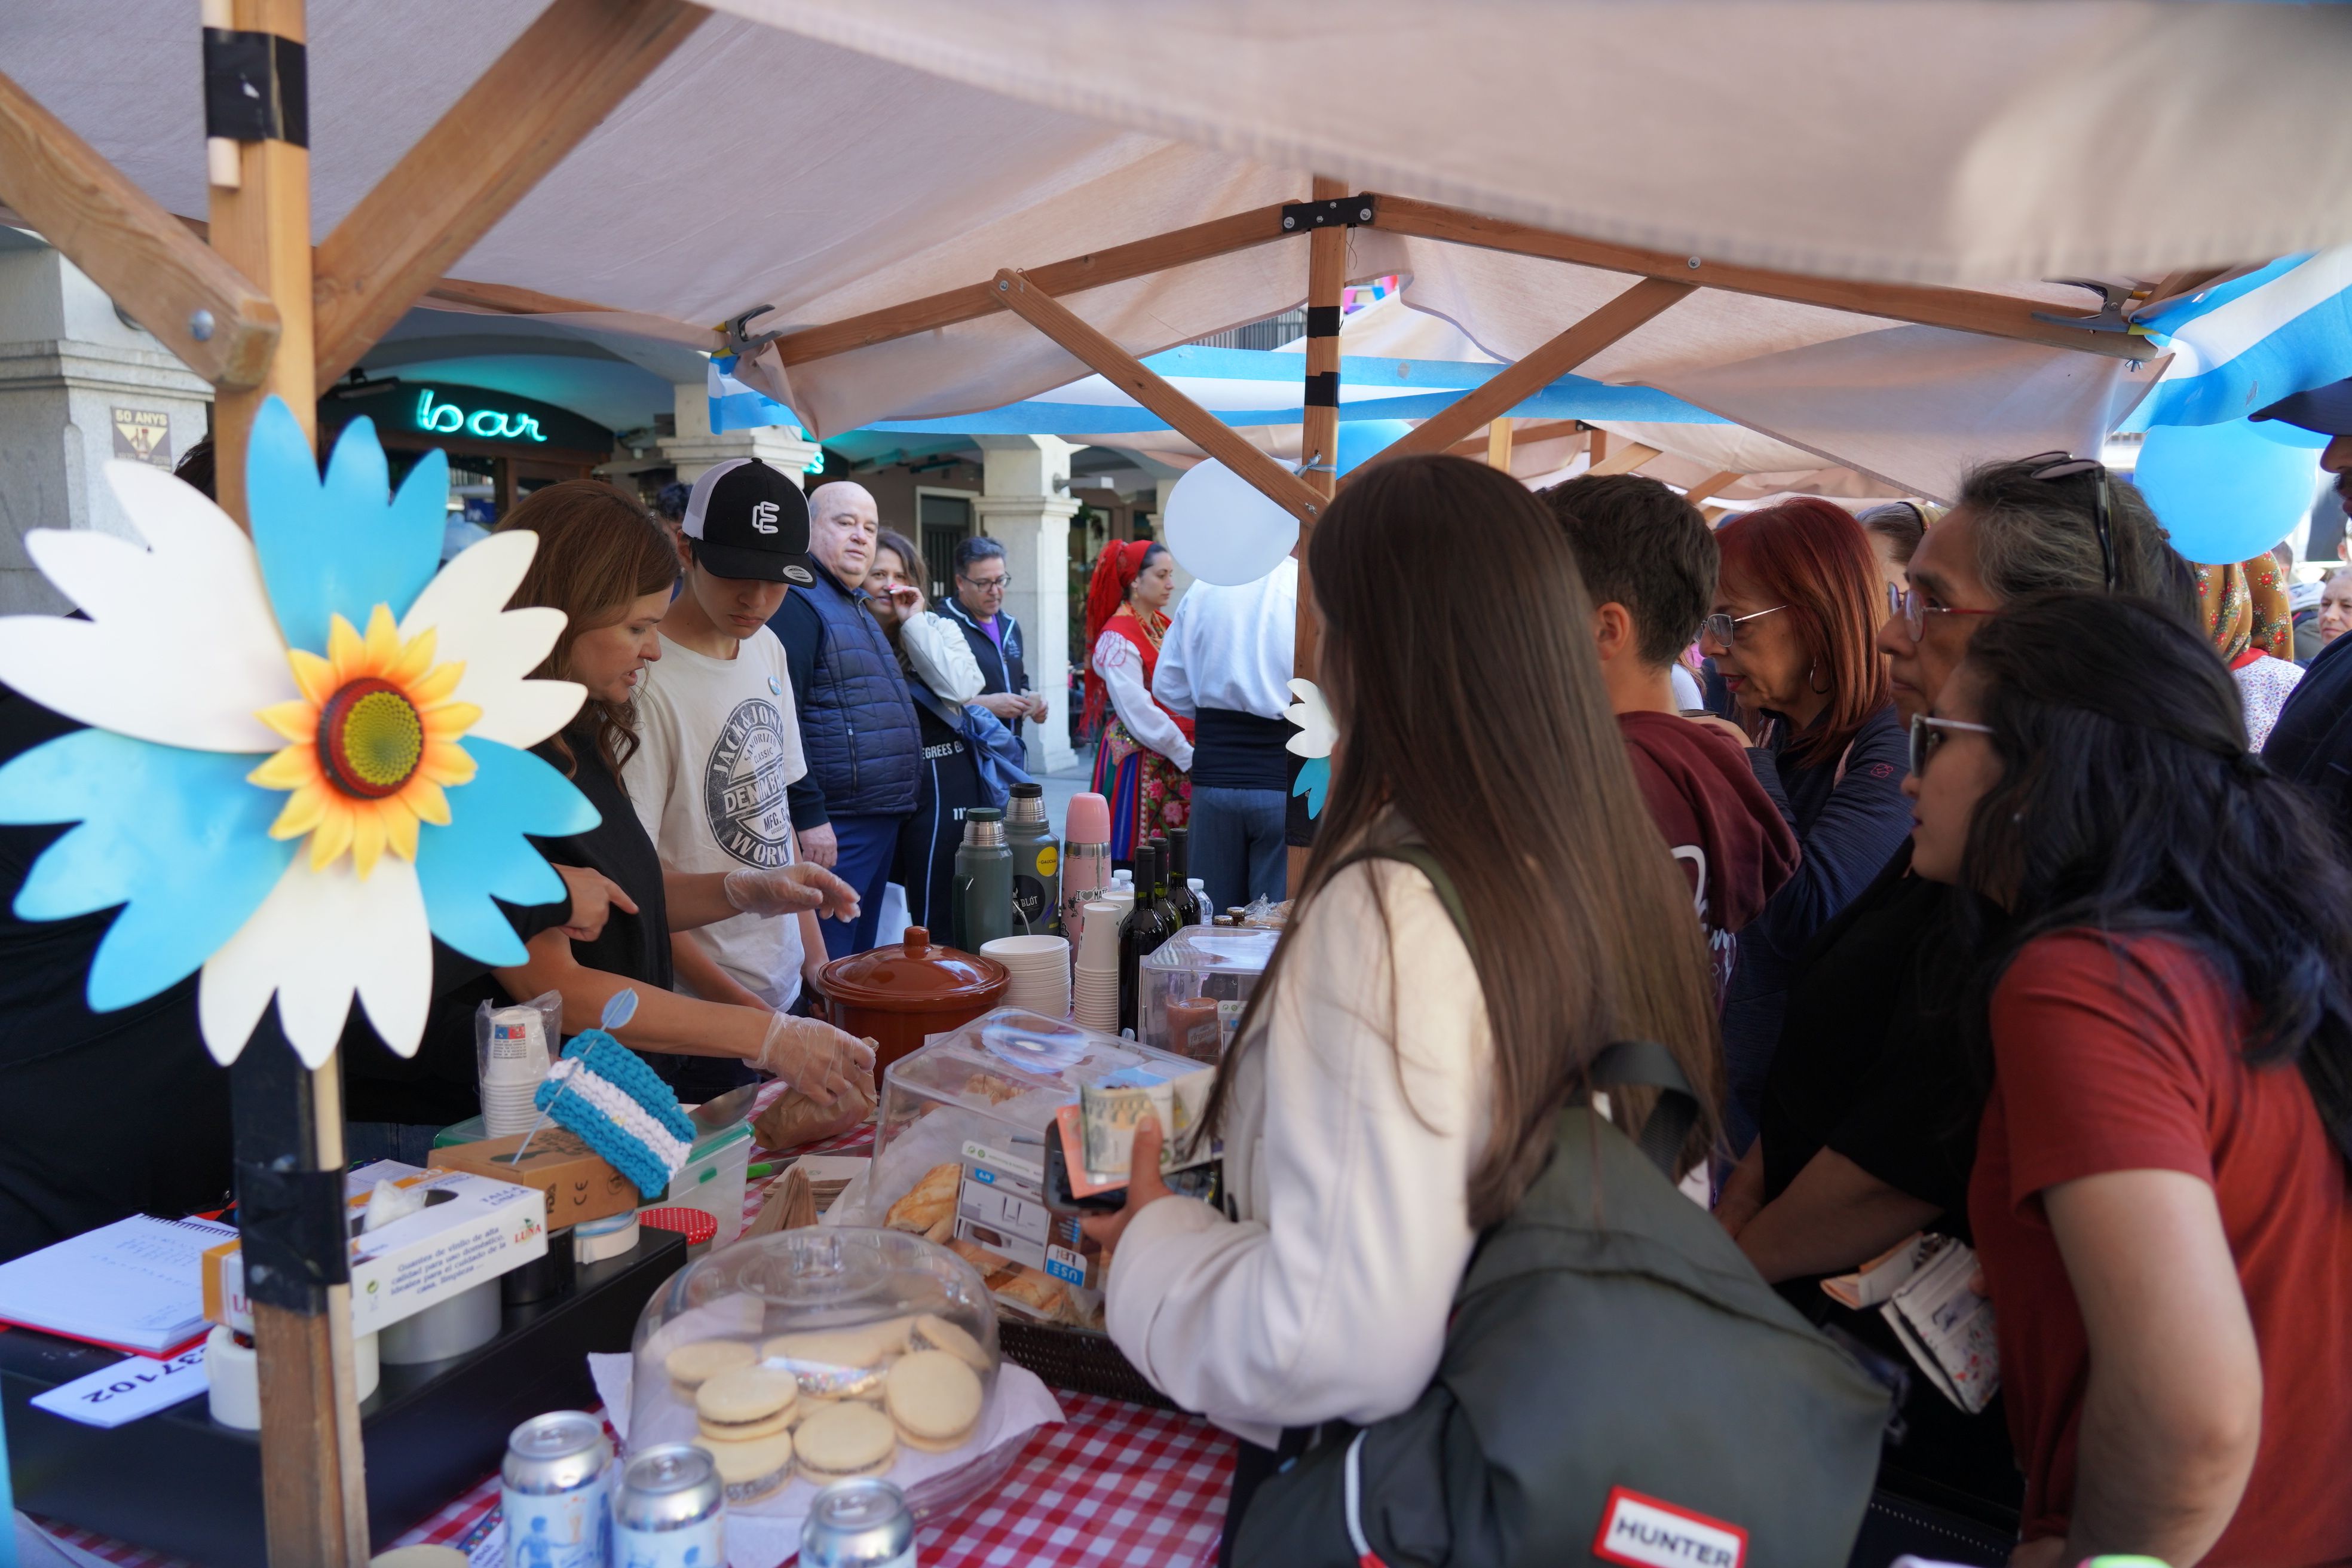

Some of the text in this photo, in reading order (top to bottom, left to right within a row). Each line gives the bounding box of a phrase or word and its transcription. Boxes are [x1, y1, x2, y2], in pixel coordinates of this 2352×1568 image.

[115, 409, 168, 427] 50 ANYS
[416, 388, 547, 442] bar
[754, 747, 774, 764] CLASSIC
[763, 811, 782, 832] MFG.
[473, 1233, 483, 1243] de
[485, 1227, 500, 1238] alta
[514, 1223, 542, 1244] LUNA
[424, 1270, 443, 1285] para
[488, 1245, 498, 1255] de
[424, 1258, 443, 1274] para
[1616, 1517, 1733, 1568] HUNTER
